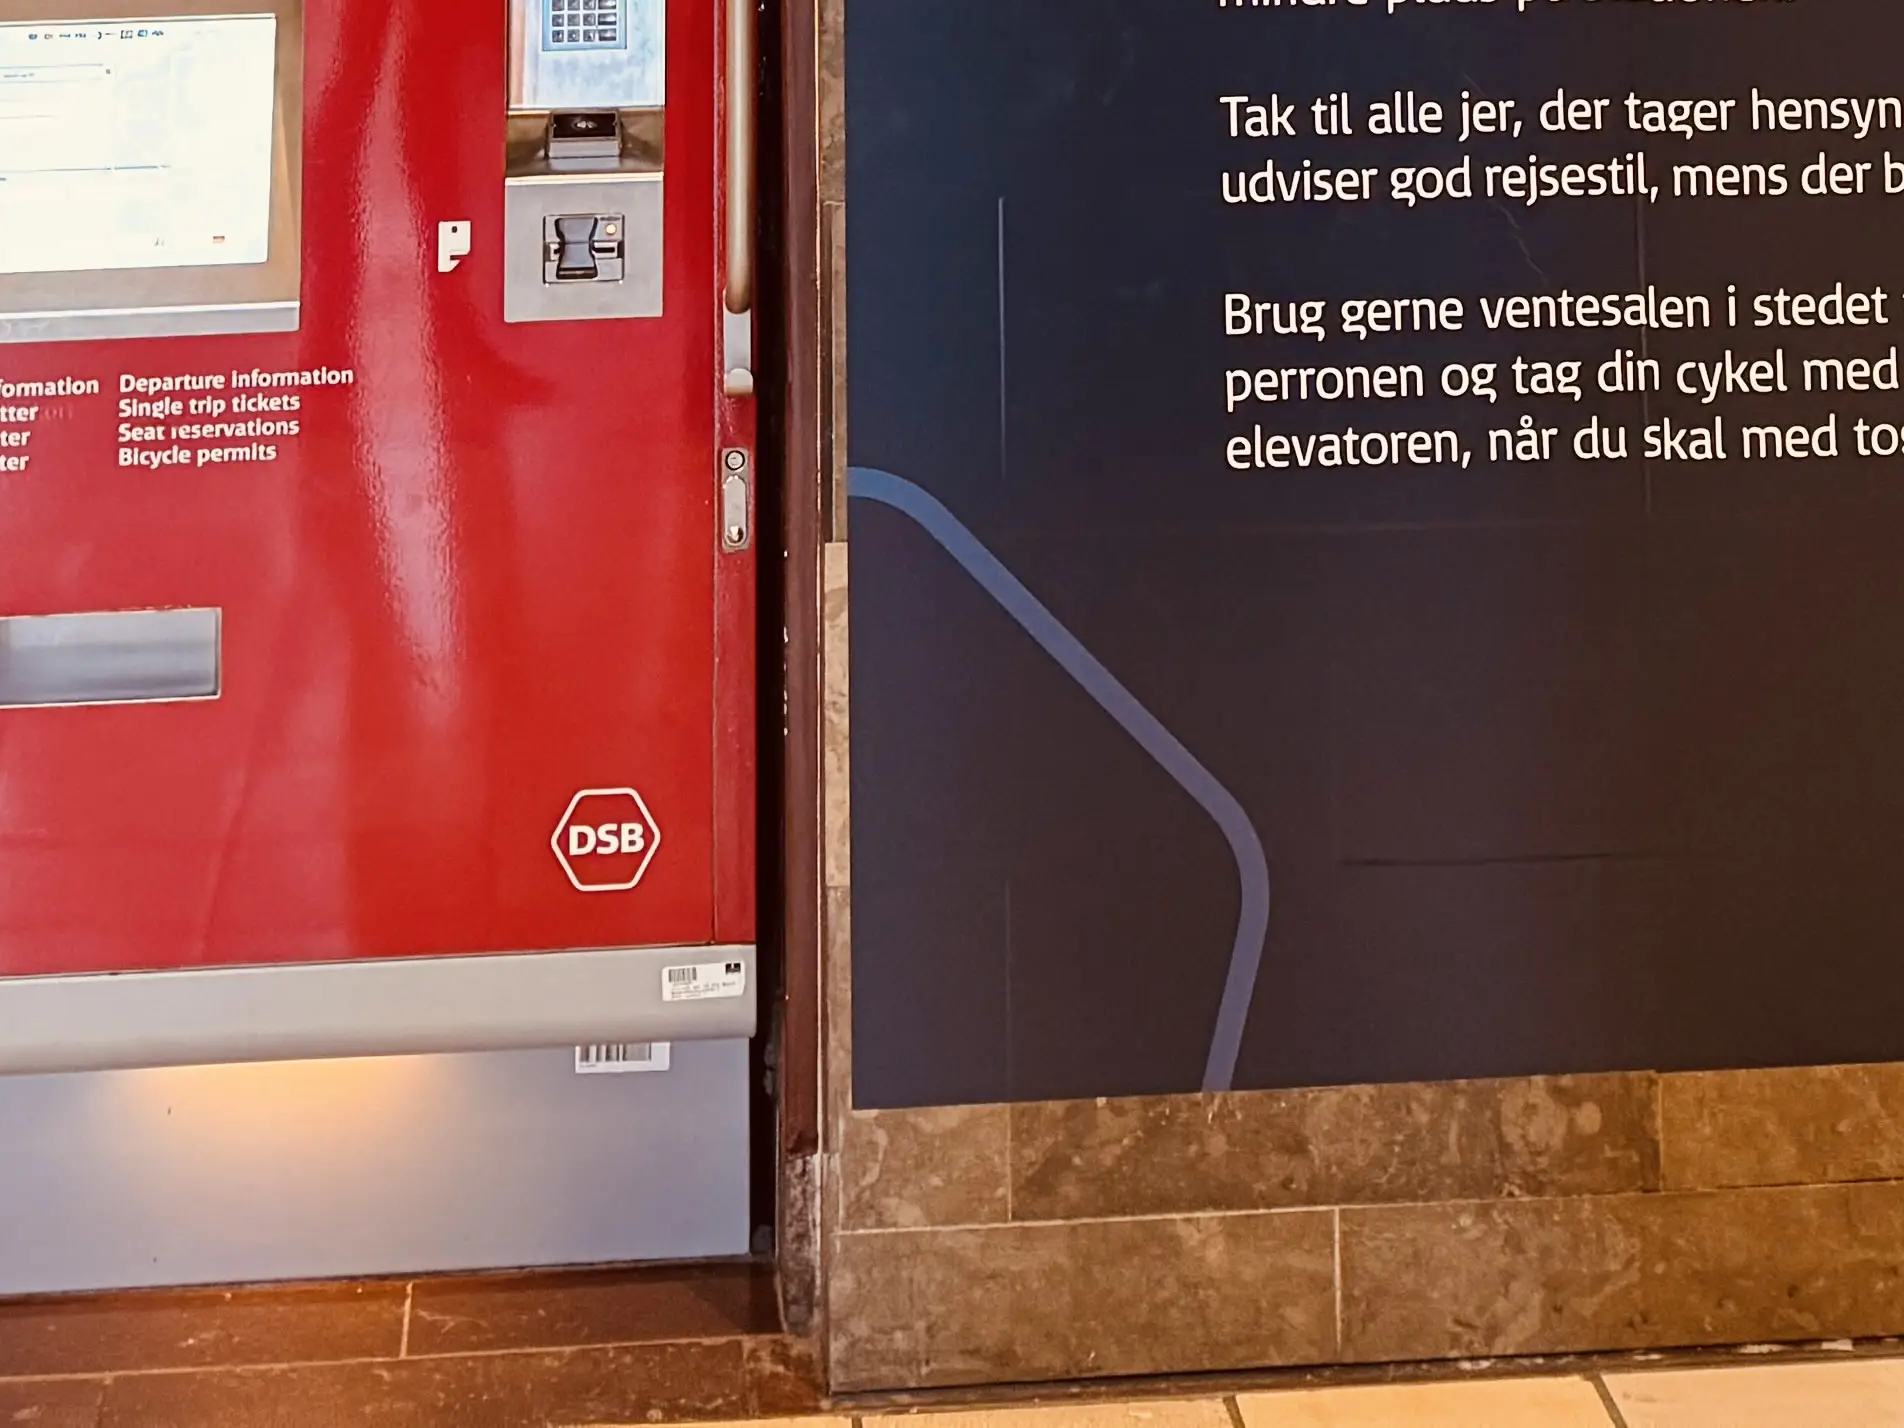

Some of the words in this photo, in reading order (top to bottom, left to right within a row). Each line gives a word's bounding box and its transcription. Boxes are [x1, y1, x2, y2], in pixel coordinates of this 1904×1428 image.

[1226, 365, 1423, 412] perronen
[1442, 364, 1497, 403] og
[1512, 356, 1581, 401] tag
[1598, 349, 1659, 392] din
[1677, 349, 1787, 403] cykel
[1803, 347, 1899, 390] med
[118, 392, 184, 419] Single
[190, 392, 226, 417] trip
[231, 389, 301, 416] tickets
[569, 824, 645, 857] DSB
